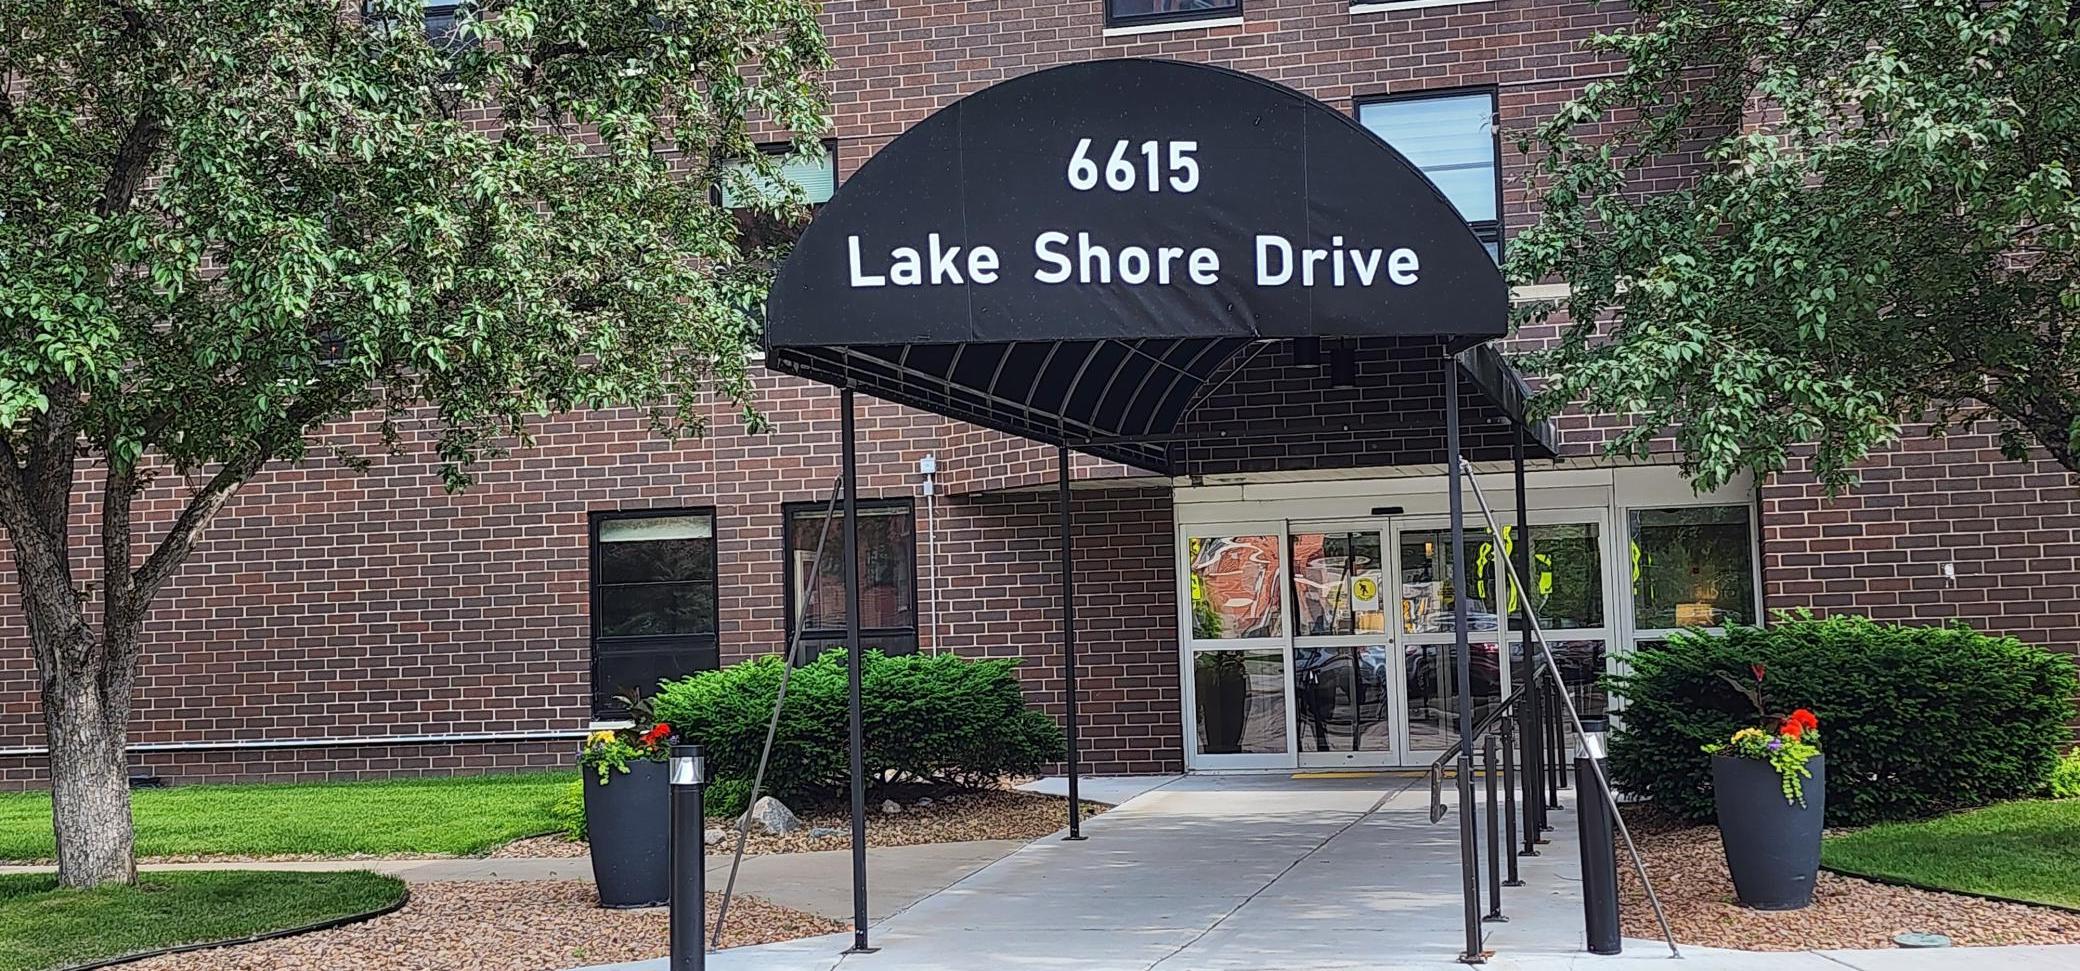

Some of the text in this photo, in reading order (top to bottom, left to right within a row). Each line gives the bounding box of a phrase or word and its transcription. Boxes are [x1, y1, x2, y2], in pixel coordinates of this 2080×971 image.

[1067, 138, 1200, 193] 6615
[848, 231, 1420, 287] Lake Shore Drive
